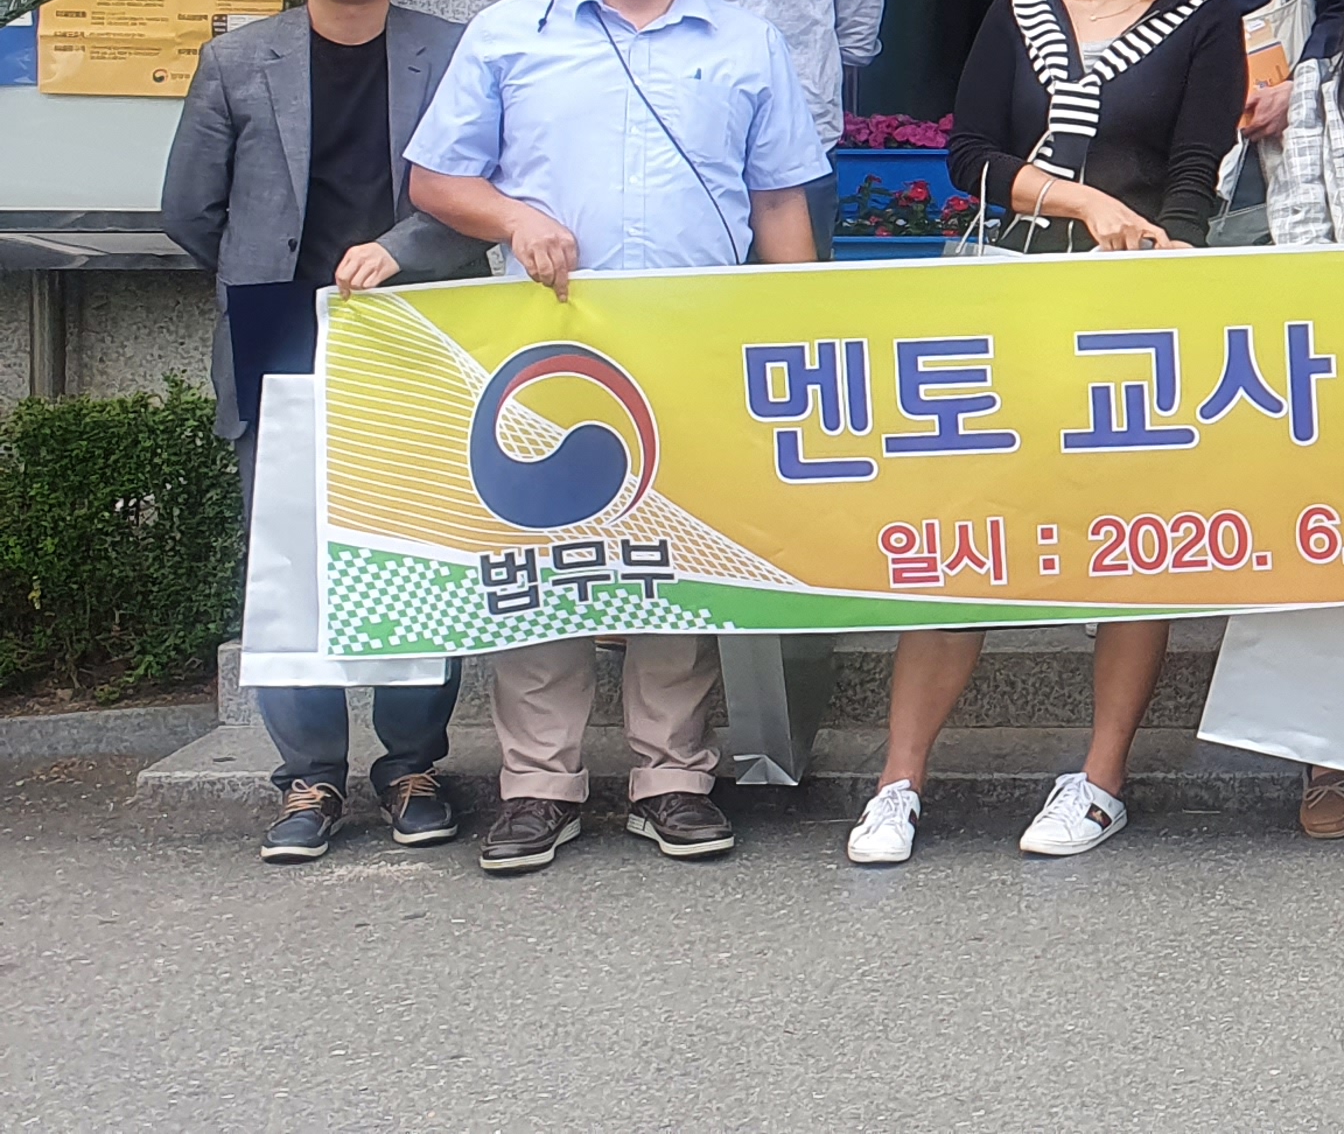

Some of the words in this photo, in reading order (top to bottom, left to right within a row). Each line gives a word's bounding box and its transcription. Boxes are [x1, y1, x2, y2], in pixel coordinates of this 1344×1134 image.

[743, 337, 1021, 484] 멘토
[1061, 321, 1337, 452] 교사
[477, 536, 678, 616] 법무부
[878, 515, 1008, 588] 일시
[1036, 522, 1062, 577] :
[1087, 508, 1272, 576] 2020.
